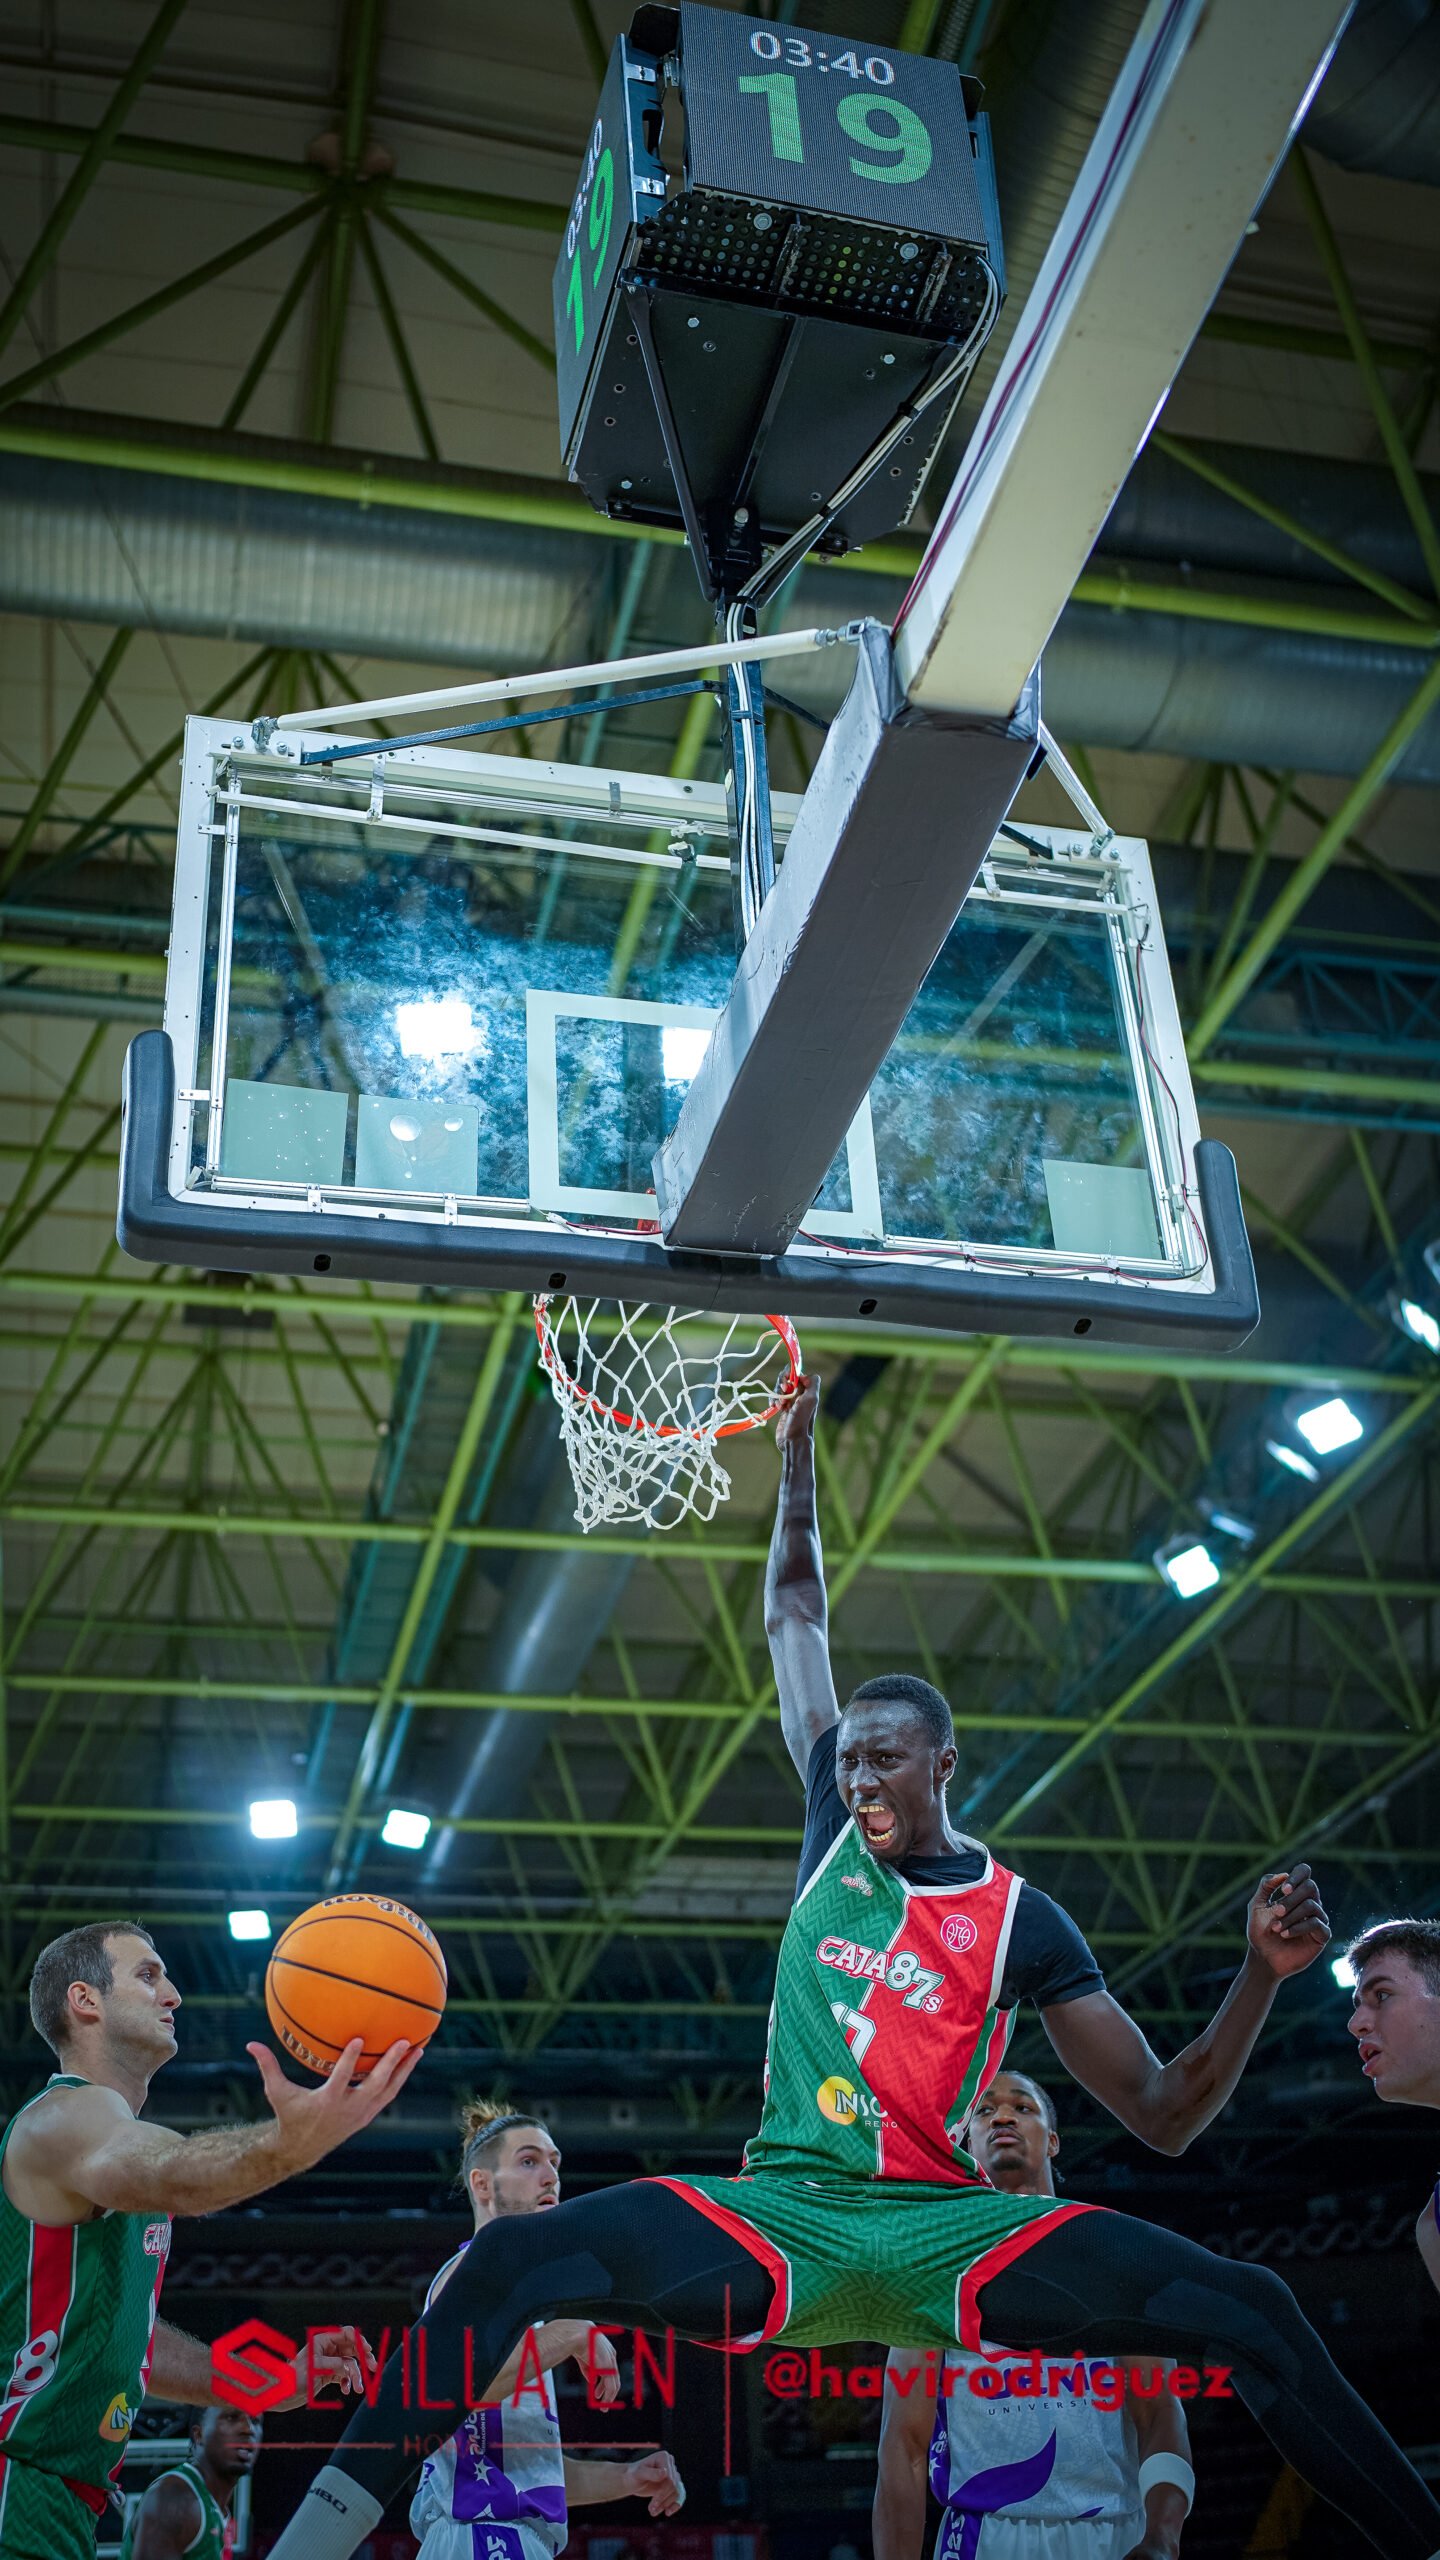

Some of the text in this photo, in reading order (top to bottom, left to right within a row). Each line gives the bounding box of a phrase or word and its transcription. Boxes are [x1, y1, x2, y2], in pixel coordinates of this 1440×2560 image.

[750, 30, 895, 86] 03:40
[738, 72, 933, 185] 19
[566, 147, 614, 356] 19
